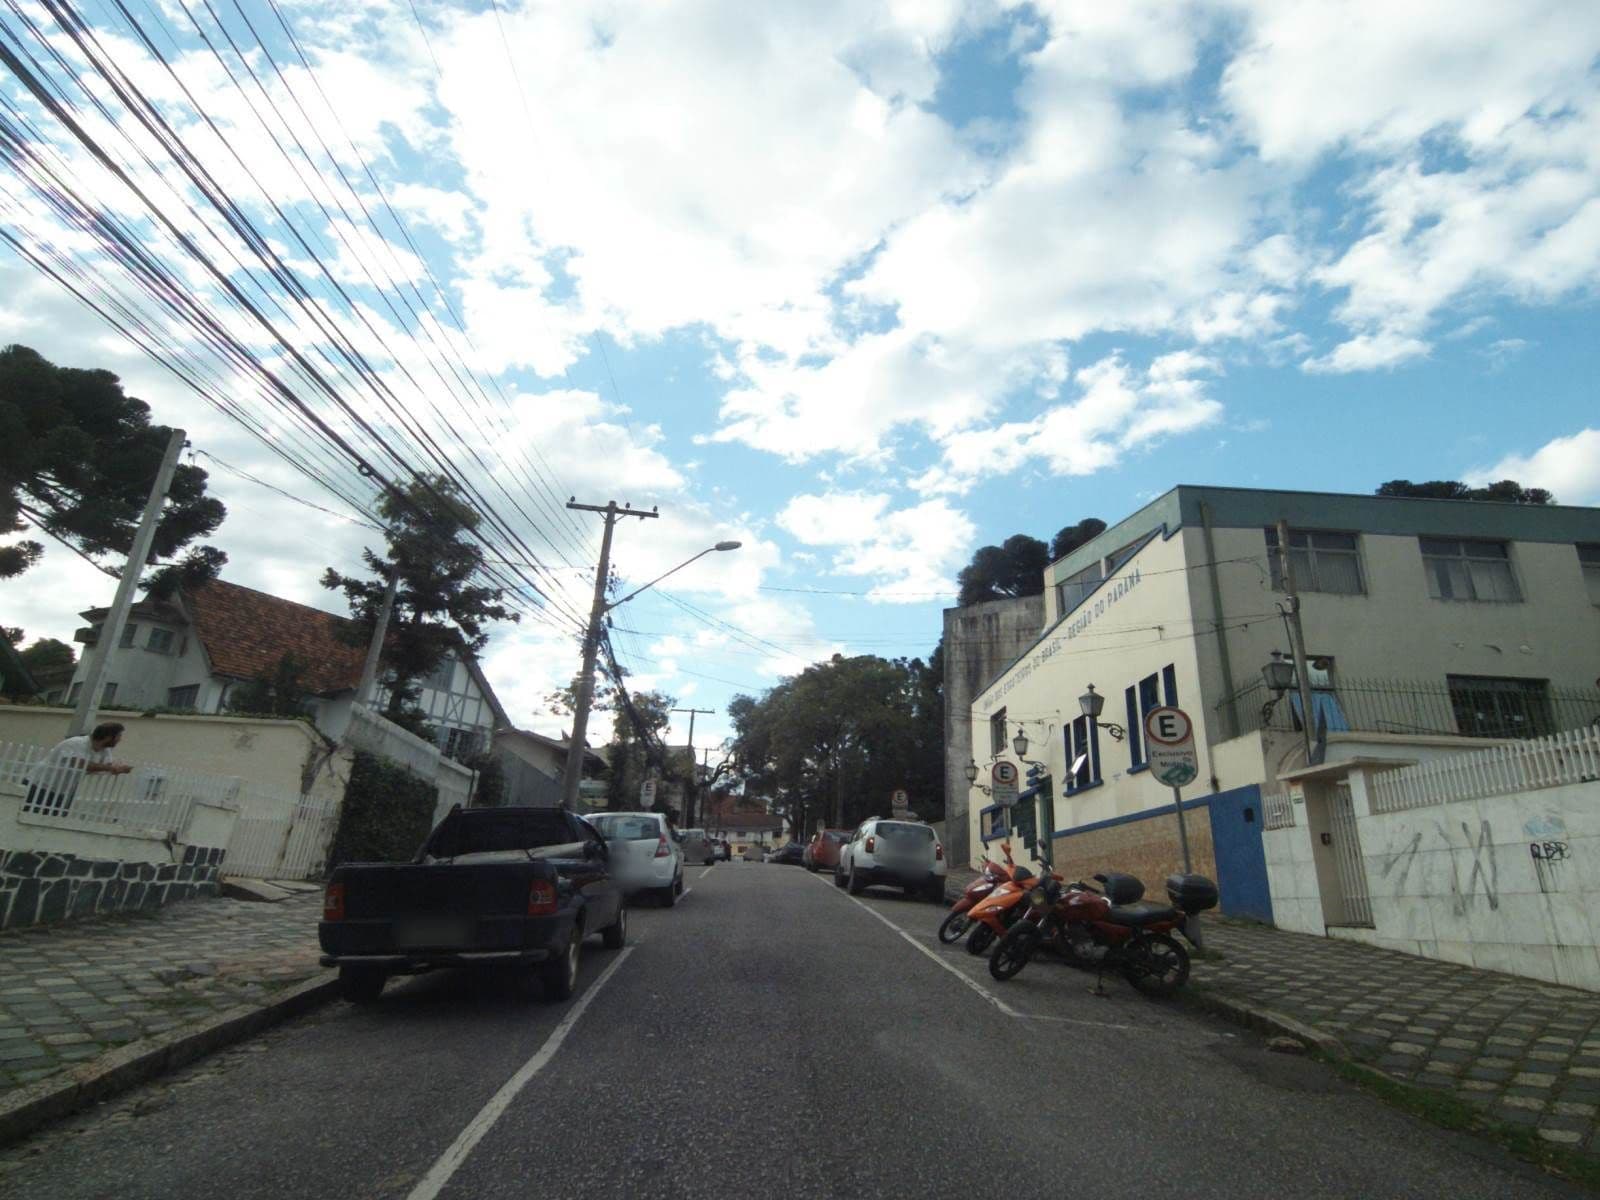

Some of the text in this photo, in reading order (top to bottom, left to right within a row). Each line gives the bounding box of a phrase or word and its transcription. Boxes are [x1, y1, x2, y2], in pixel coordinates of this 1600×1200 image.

[1094, 599, 1105, 619] DO
[1107, 561, 1142, 608] PARANÁ
[1159, 714, 1178, 738] E
[1000, 765, 1010, 780] E
